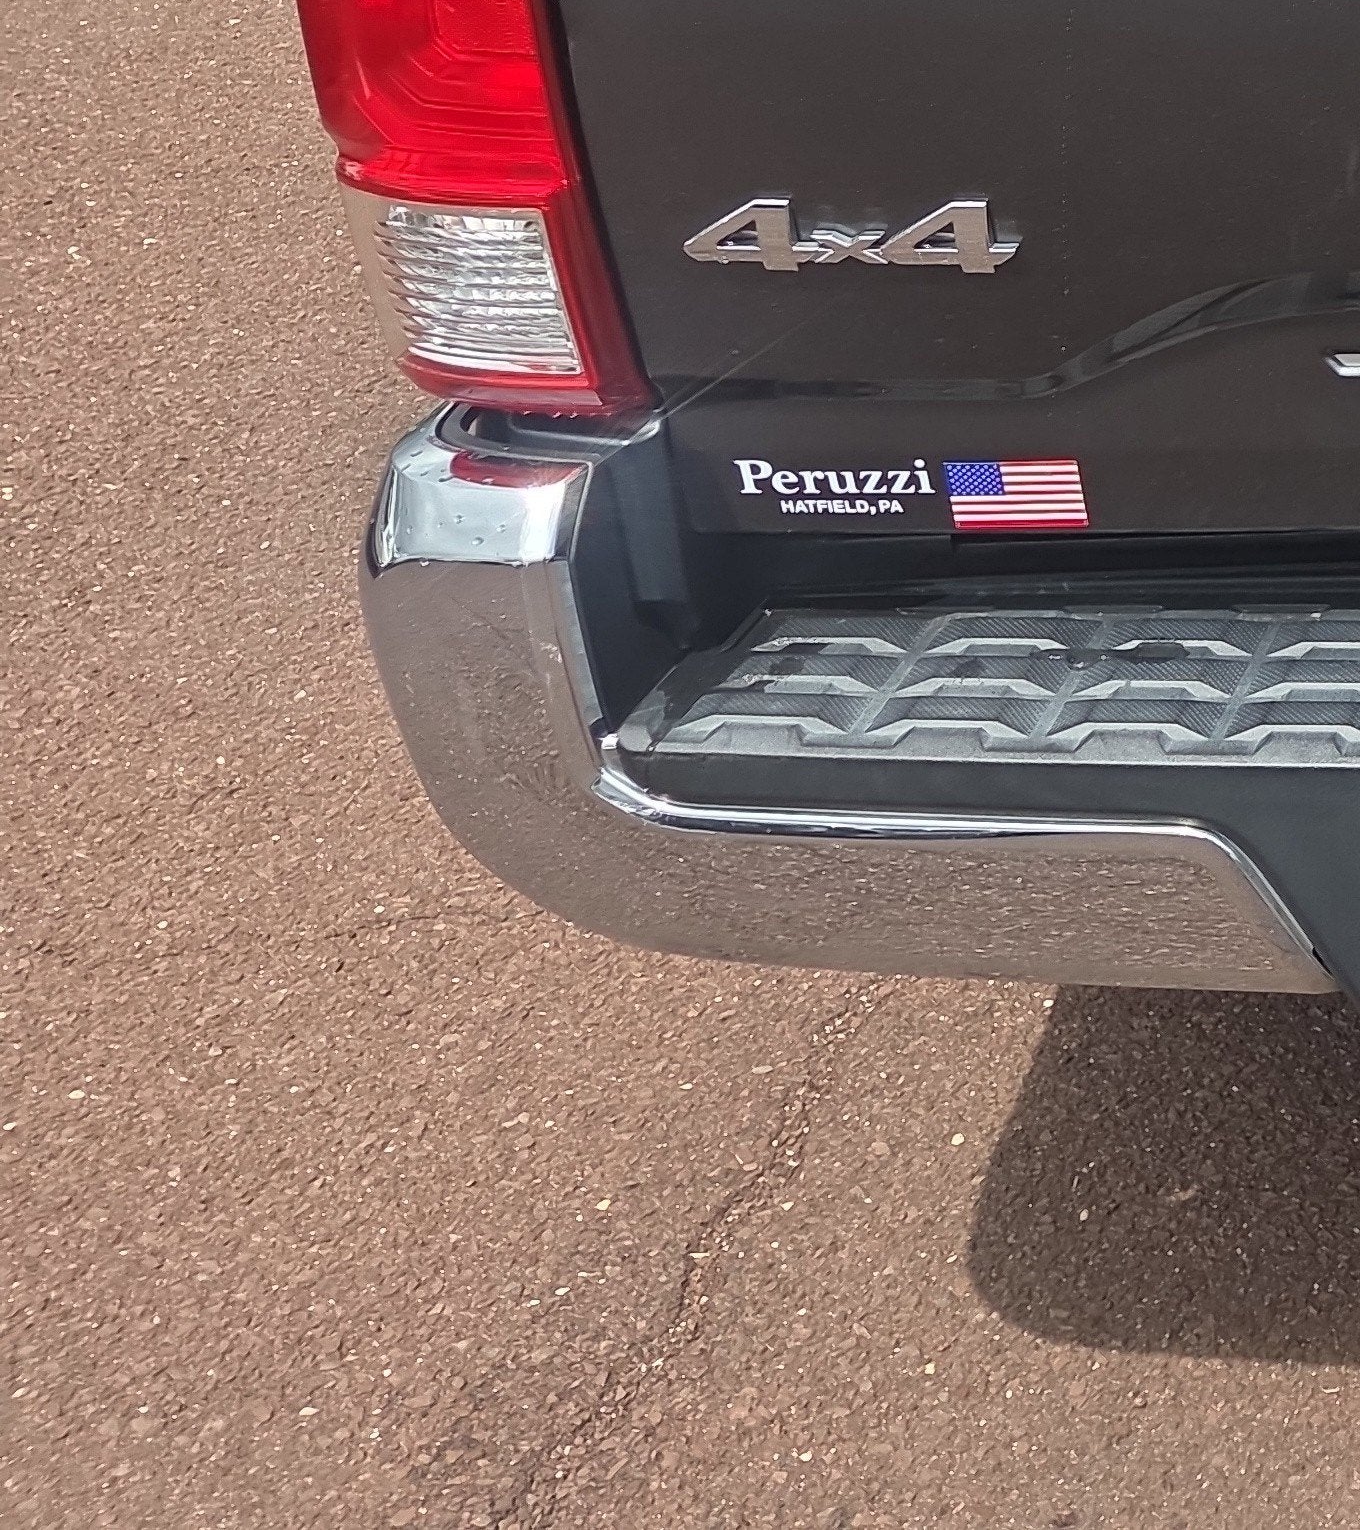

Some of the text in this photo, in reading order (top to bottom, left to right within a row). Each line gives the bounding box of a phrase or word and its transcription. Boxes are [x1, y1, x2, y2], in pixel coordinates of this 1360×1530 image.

[682, 195, 1021, 274] 4x4
[732, 458, 936, 495] Peruzzi
[779, 499, 905, 516] HATFIELD, PA
